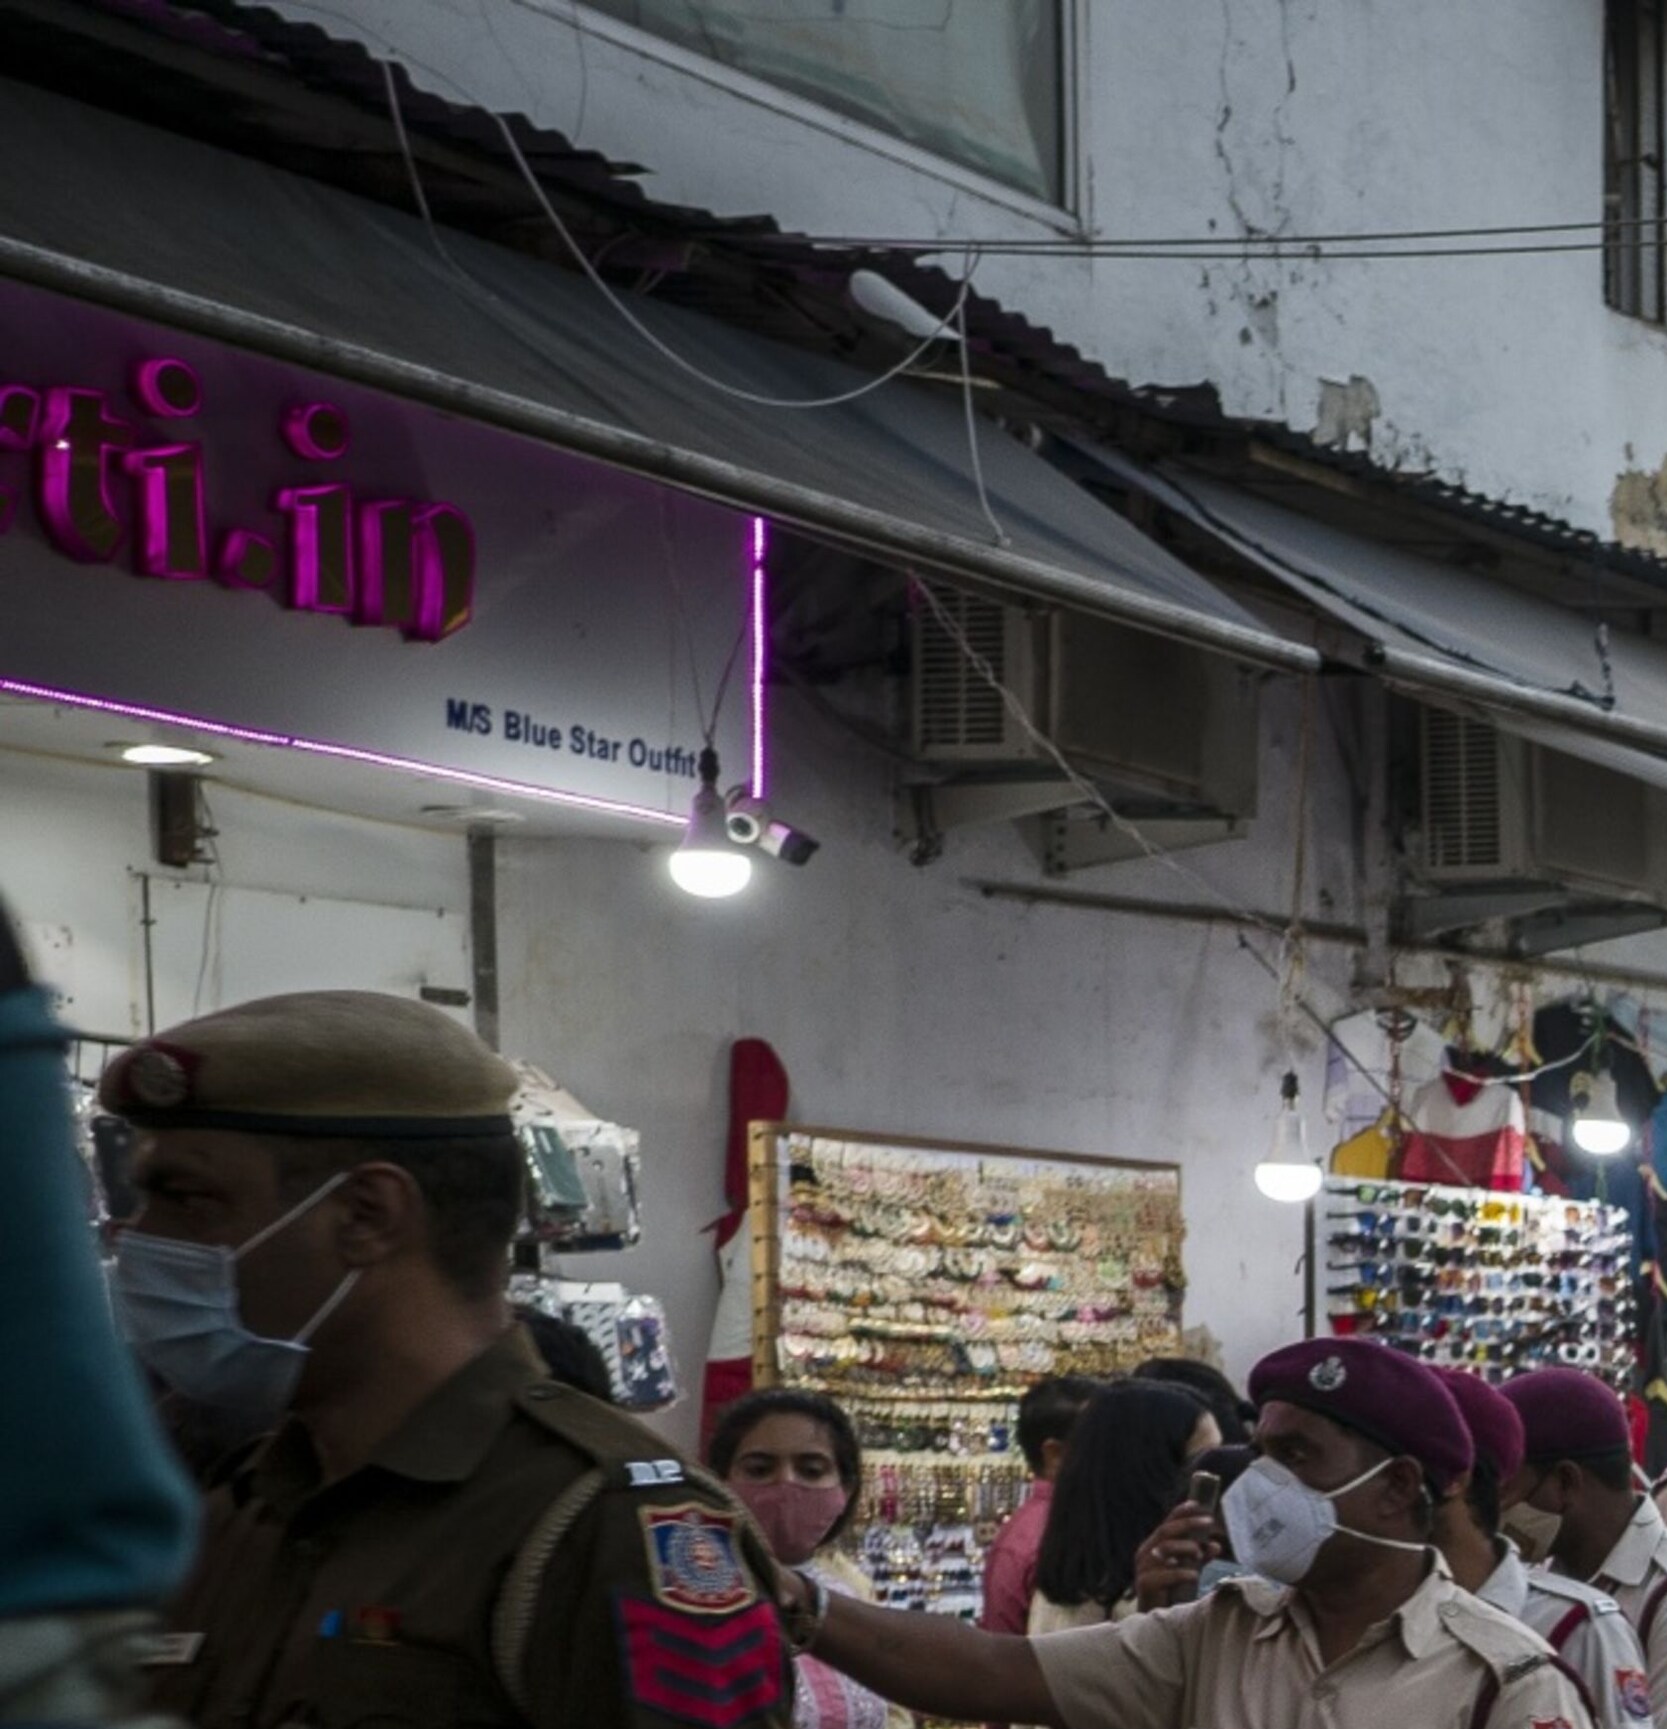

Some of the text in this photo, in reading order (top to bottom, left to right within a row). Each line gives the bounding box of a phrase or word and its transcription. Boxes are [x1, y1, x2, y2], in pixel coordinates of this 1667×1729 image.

[446, 697, 493, 736] M/S
[504, 710, 562, 751] Blue
[569, 725, 623, 764] Star
